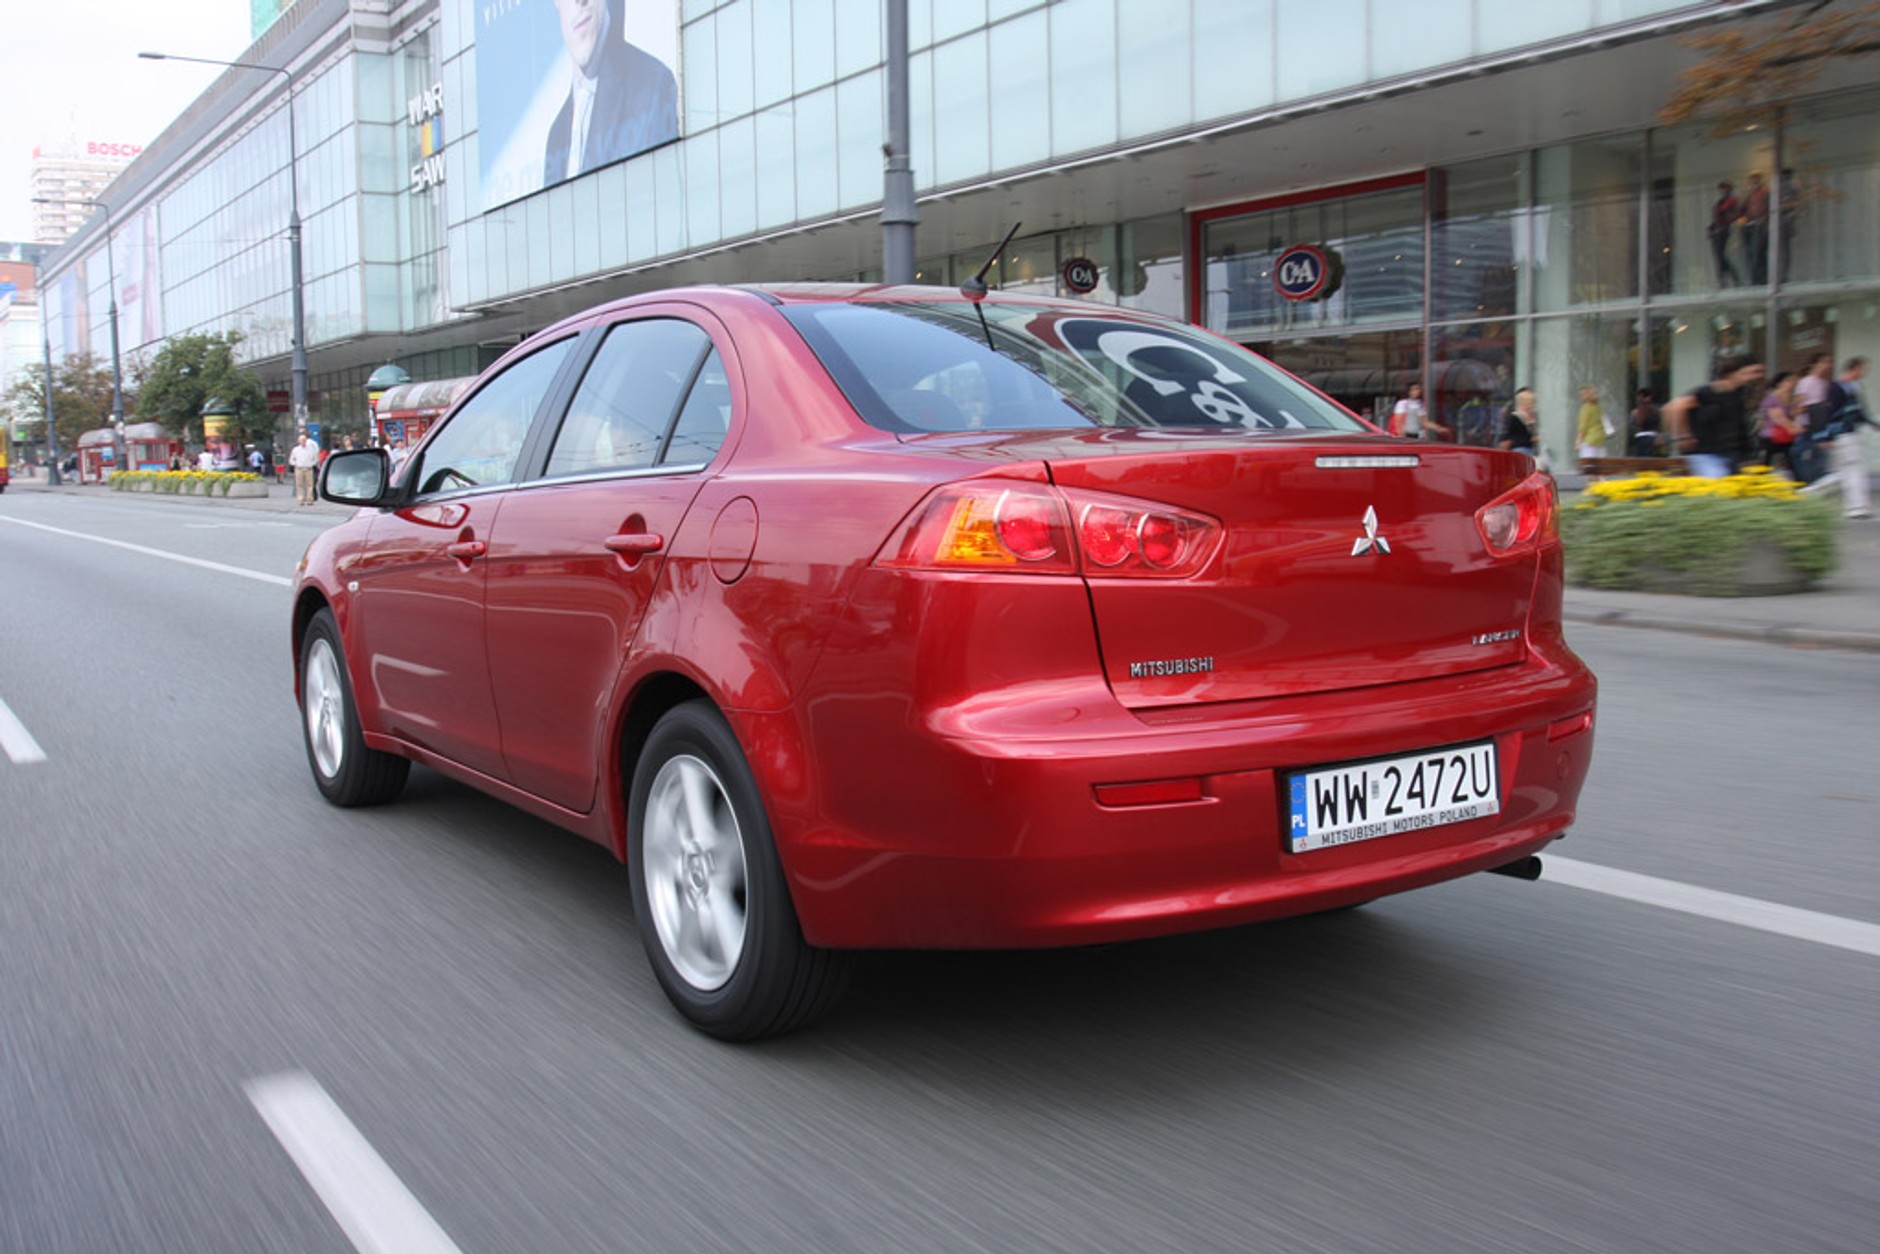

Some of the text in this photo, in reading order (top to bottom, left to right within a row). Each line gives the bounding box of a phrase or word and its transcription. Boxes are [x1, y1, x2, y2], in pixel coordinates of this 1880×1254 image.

[408, 82, 443, 126] WAR
[87, 142, 142, 157] BOSCH
[411, 151, 446, 194] SAW
[1130, 656, 1213, 678] MITSUBISHI
[1315, 750, 1491, 829] WW 2472U
[1292, 814, 1305, 829] PL
[1321, 805, 1478, 846] MITSUBISHI MOTORS POLAND
